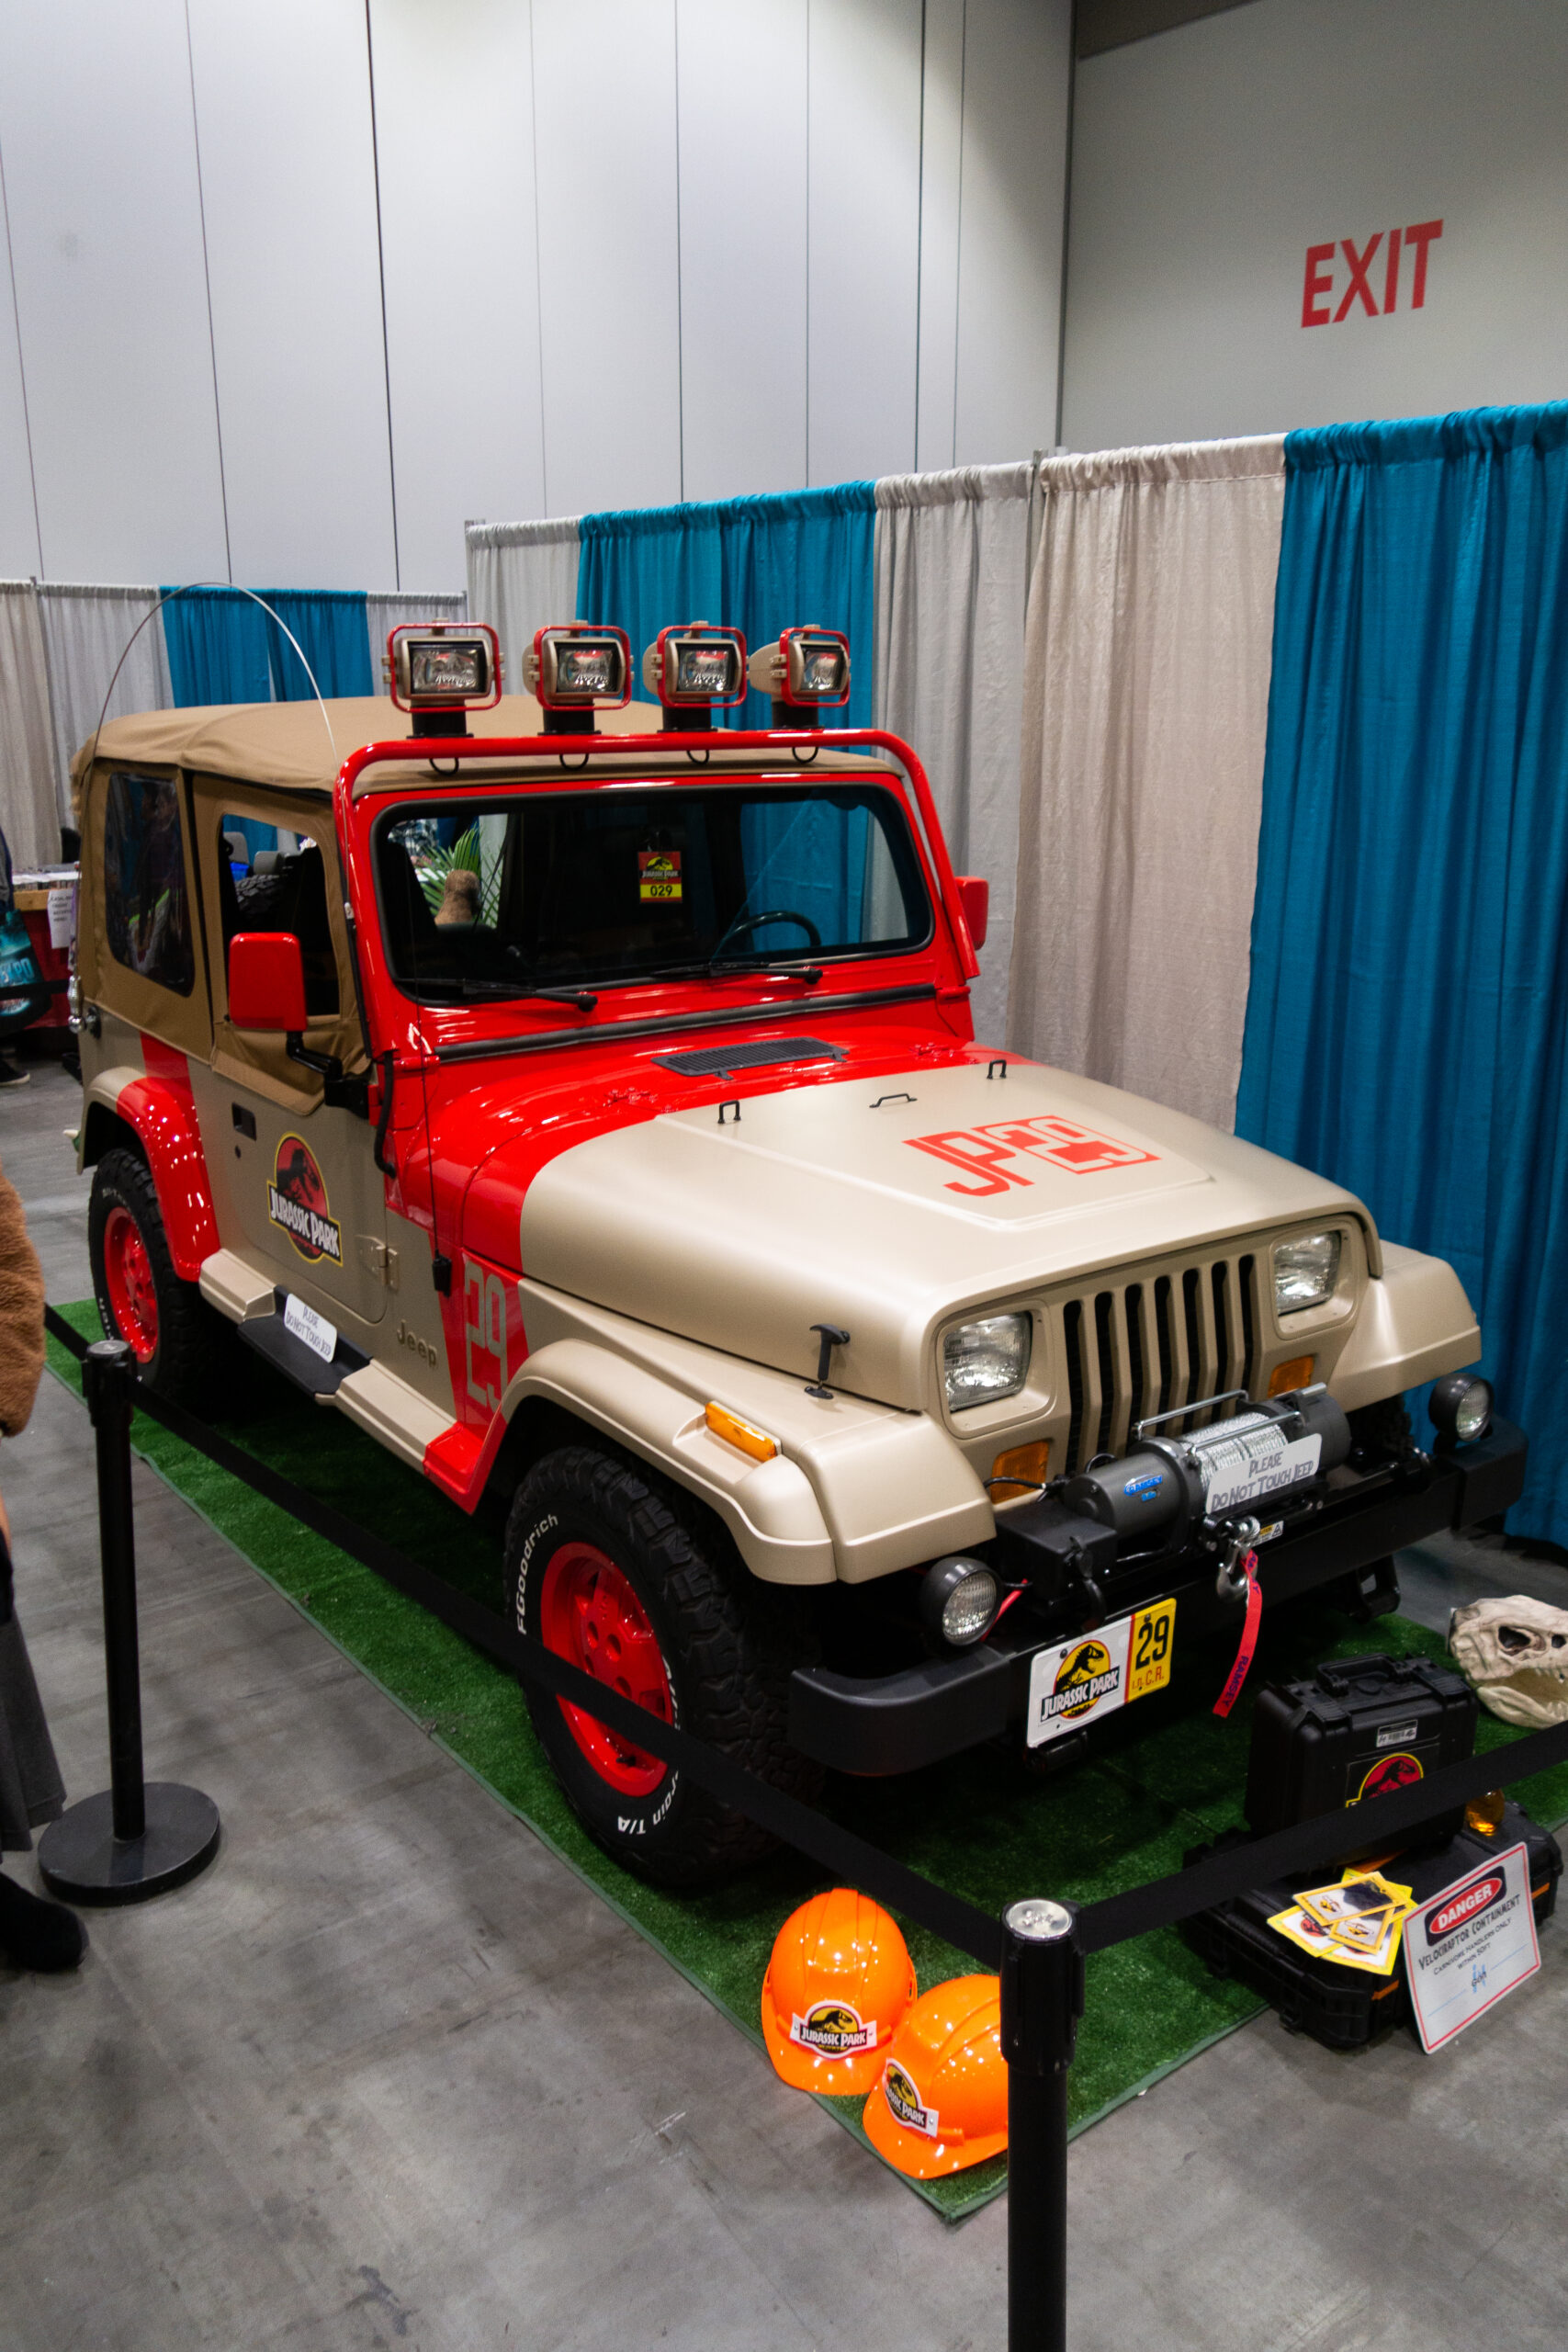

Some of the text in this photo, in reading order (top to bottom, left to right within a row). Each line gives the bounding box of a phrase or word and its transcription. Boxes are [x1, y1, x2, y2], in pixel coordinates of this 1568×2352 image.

[1301, 219, 1444, 328] EXIT
[650, 885, 673, 897] 029
[270, 1187, 340, 1258] JURASSIC PARK
[293, 1317, 305, 1336] NOT
[321, 1339, 332, 1356] JEEP
[397, 1318, 438, 1368] Jeep
[464, 1260, 512, 1415] 29
[1212, 1460, 1314, 1512] DO NOT TOUCH JEEP
[1248, 1451, 1283, 1478] PLEASE
[516, 1513, 558, 1635] FGoodrich
[1135, 1614, 1169, 1671] 29
[1041, 1668, 1120, 1721] JURASSIC PARK
[1223, 1655, 1249, 1707] RAMSEY
[617, 1815, 647, 1835] T/A
[1418, 1894, 1520, 1970] VELOCIRAPTOR CONTAINMENT
[1438, 1883, 1493, 1929] DANGER
[1433, 1917, 1512, 1975] CARNIVORE HANDLERS ONLY
[800, 2026, 866, 2048] JURASSIC PARK
[901, 2101, 925, 2126] PARK
